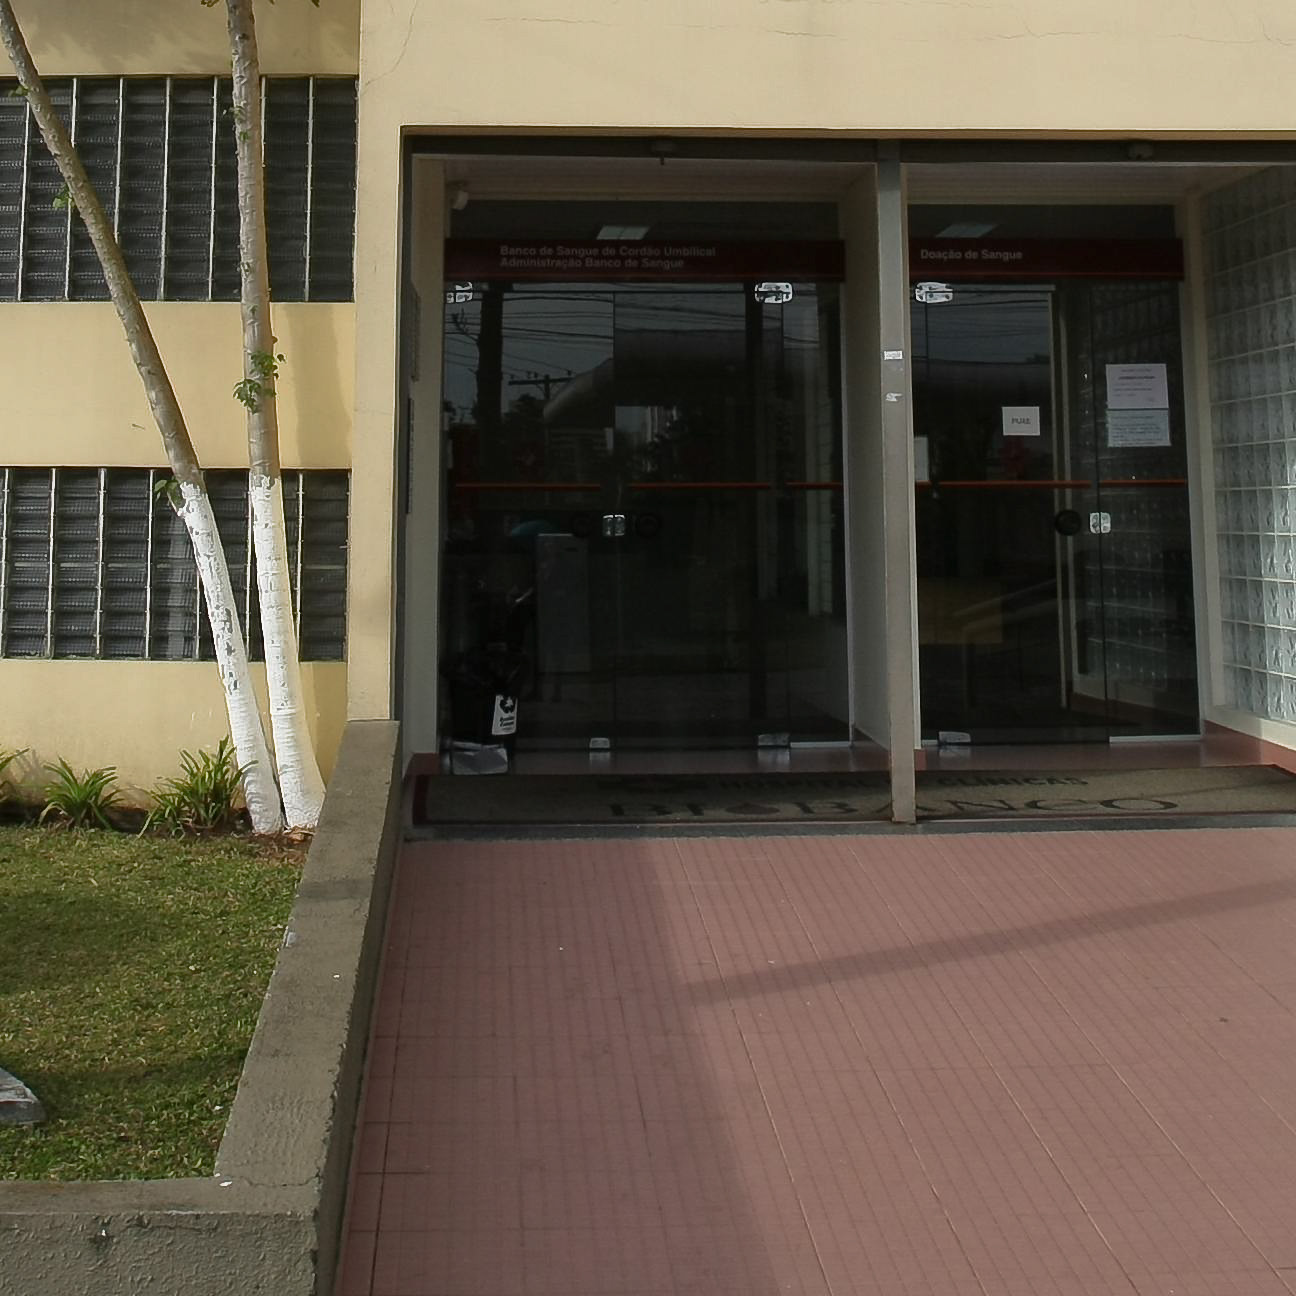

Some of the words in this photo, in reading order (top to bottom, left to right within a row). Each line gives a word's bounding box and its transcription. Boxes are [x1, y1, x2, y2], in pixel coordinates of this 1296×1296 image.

[500, 245, 537, 257] Banco
[539, 245, 554, 257] de
[556, 245, 599, 259] Sangue
[601, 245, 616, 257] de
[619, 245, 661, 257] Cordão
[664, 245, 717, 257] Umbilical
[920, 249, 962, 262] Doação
[964, 249, 979, 260] de
[981, 249, 1024, 262] Sangue
[500, 257, 583, 270] Administração
[585, 257, 622, 268] Banco
[624, 257, 639, 268] de
[641, 257, 685, 271] Sangue
